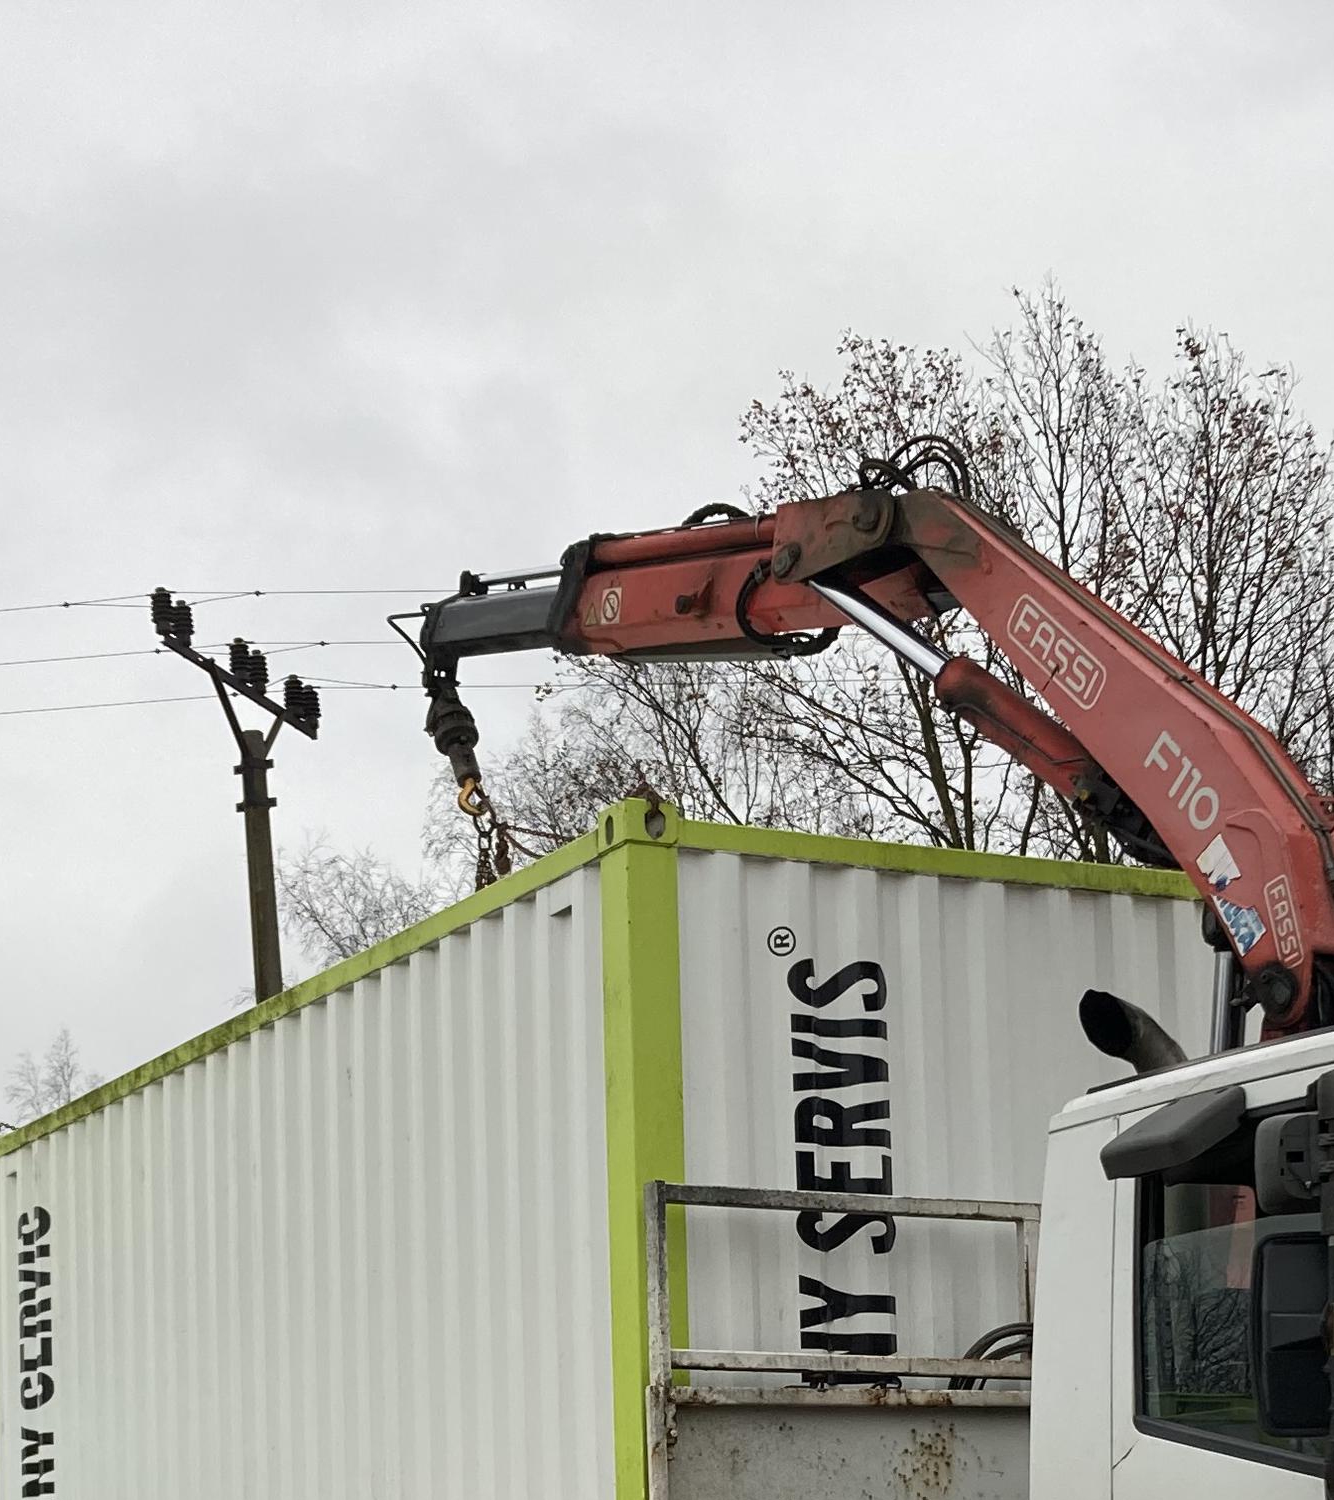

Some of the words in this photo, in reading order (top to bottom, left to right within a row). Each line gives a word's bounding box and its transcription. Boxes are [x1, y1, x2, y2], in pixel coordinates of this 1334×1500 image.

[1013, 603, 1099, 700] FASSI
[1143, 731, 1219, 830] F110
[1270, 884, 1299, 964] FASSI
